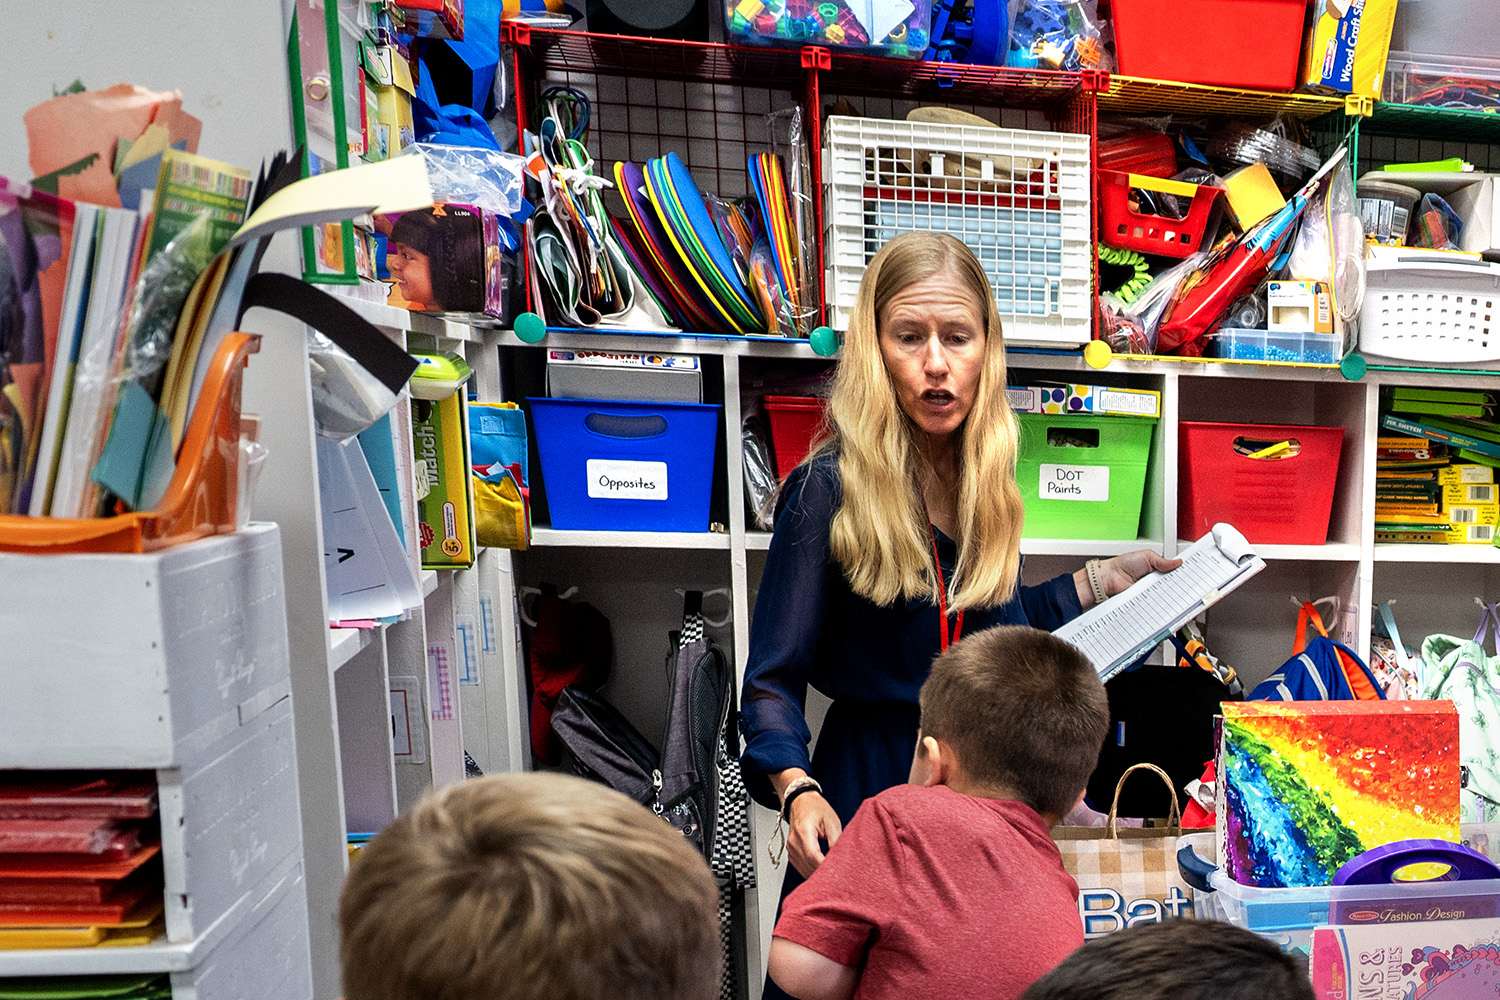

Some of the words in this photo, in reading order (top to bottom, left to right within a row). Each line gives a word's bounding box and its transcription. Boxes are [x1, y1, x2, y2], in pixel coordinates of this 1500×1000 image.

[1347, 17, 1361, 47] Craft
[1340, 48, 1356, 82] Wood
[577, 351, 640, 360] OPPOSITES
[1397, 422, 1422, 433] SKETCH
[1056, 468, 1084, 481] DOT
[599, 475, 656, 490] Opposites
[1047, 482, 1082, 495] Paints
[449, 540, 459, 552] 5+
[1380, 909, 1422, 922] Fashion
[1426, 907, 1465, 920] Design
[1359, 947, 1385, 966] &
